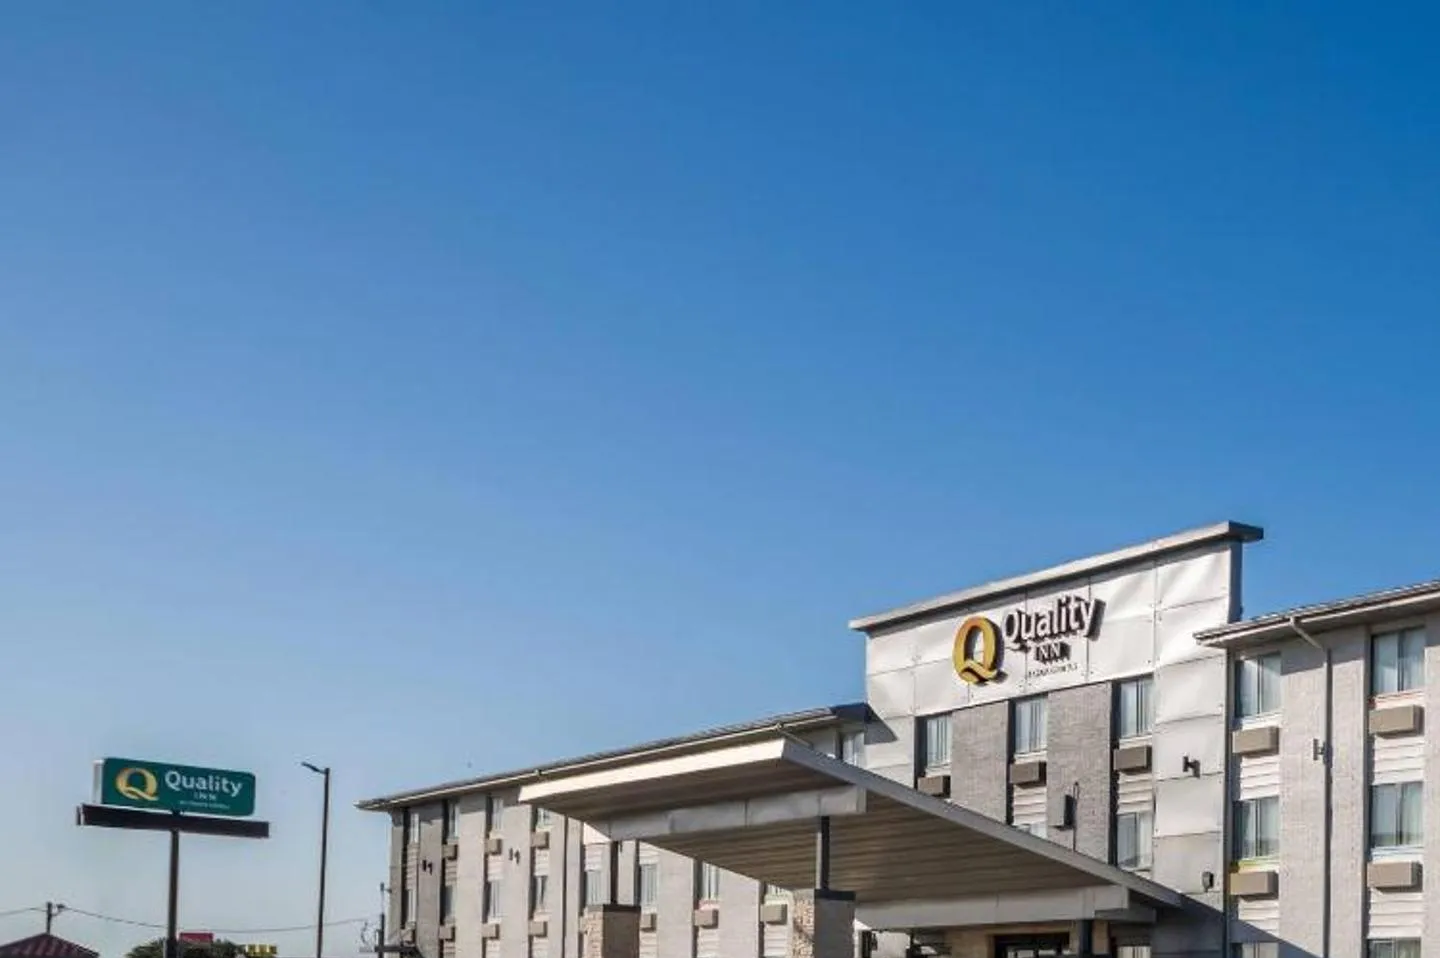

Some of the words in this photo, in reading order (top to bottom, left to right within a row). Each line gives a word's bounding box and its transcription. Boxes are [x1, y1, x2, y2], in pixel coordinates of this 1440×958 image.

[1004, 597, 1099, 650] Quality
[953, 616, 1001, 685] Q
[1033, 641, 1064, 662] INN
[115, 767, 159, 801] Q
[164, 771, 243, 797] Quality
